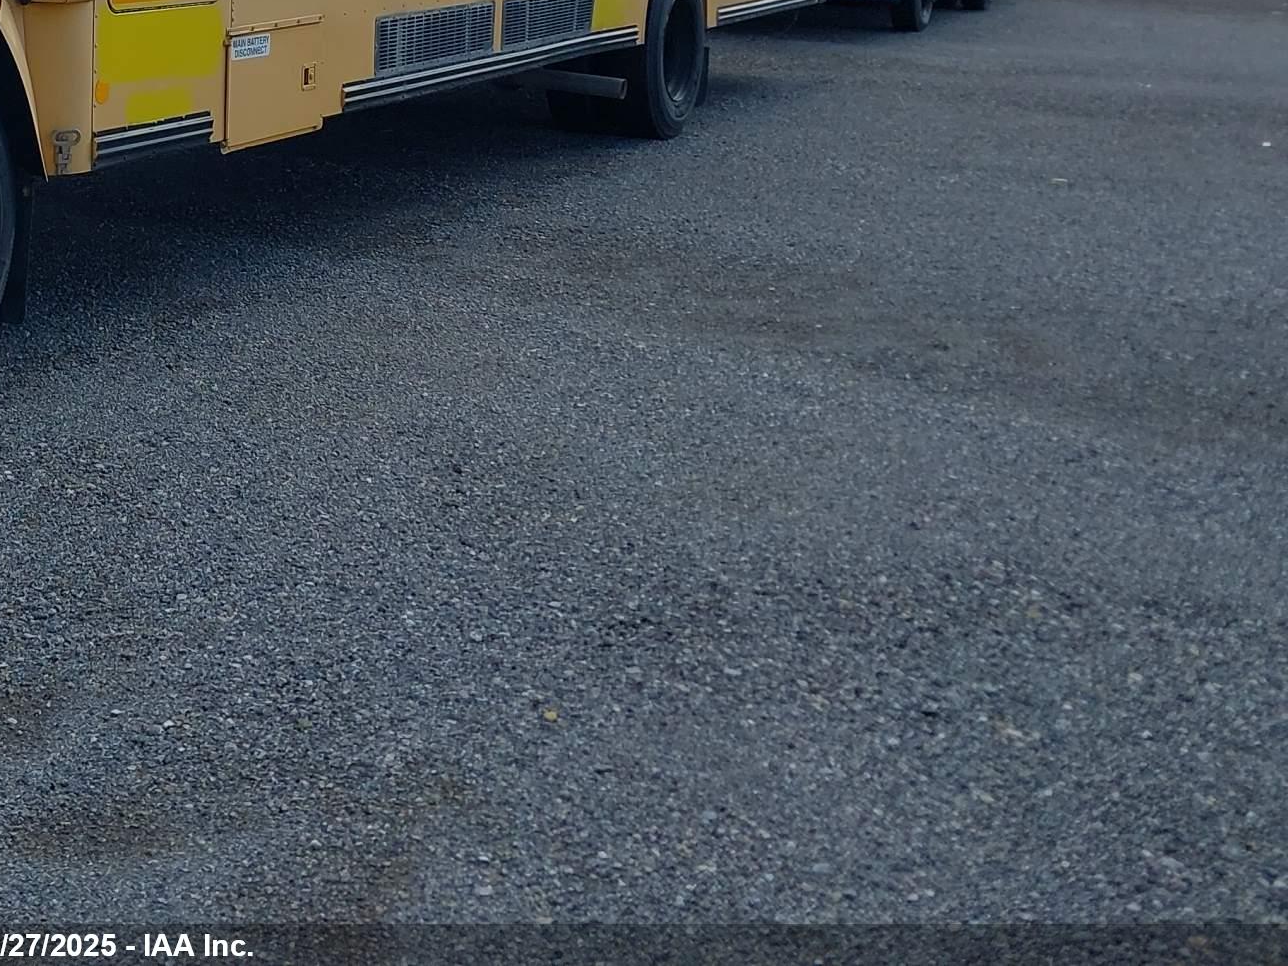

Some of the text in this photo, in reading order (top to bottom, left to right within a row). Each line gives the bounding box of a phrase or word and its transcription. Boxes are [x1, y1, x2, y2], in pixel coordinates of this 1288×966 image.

[233, 35, 270, 48] MAIN BATTERY
[234, 45, 268, 58] DISCONNECT
